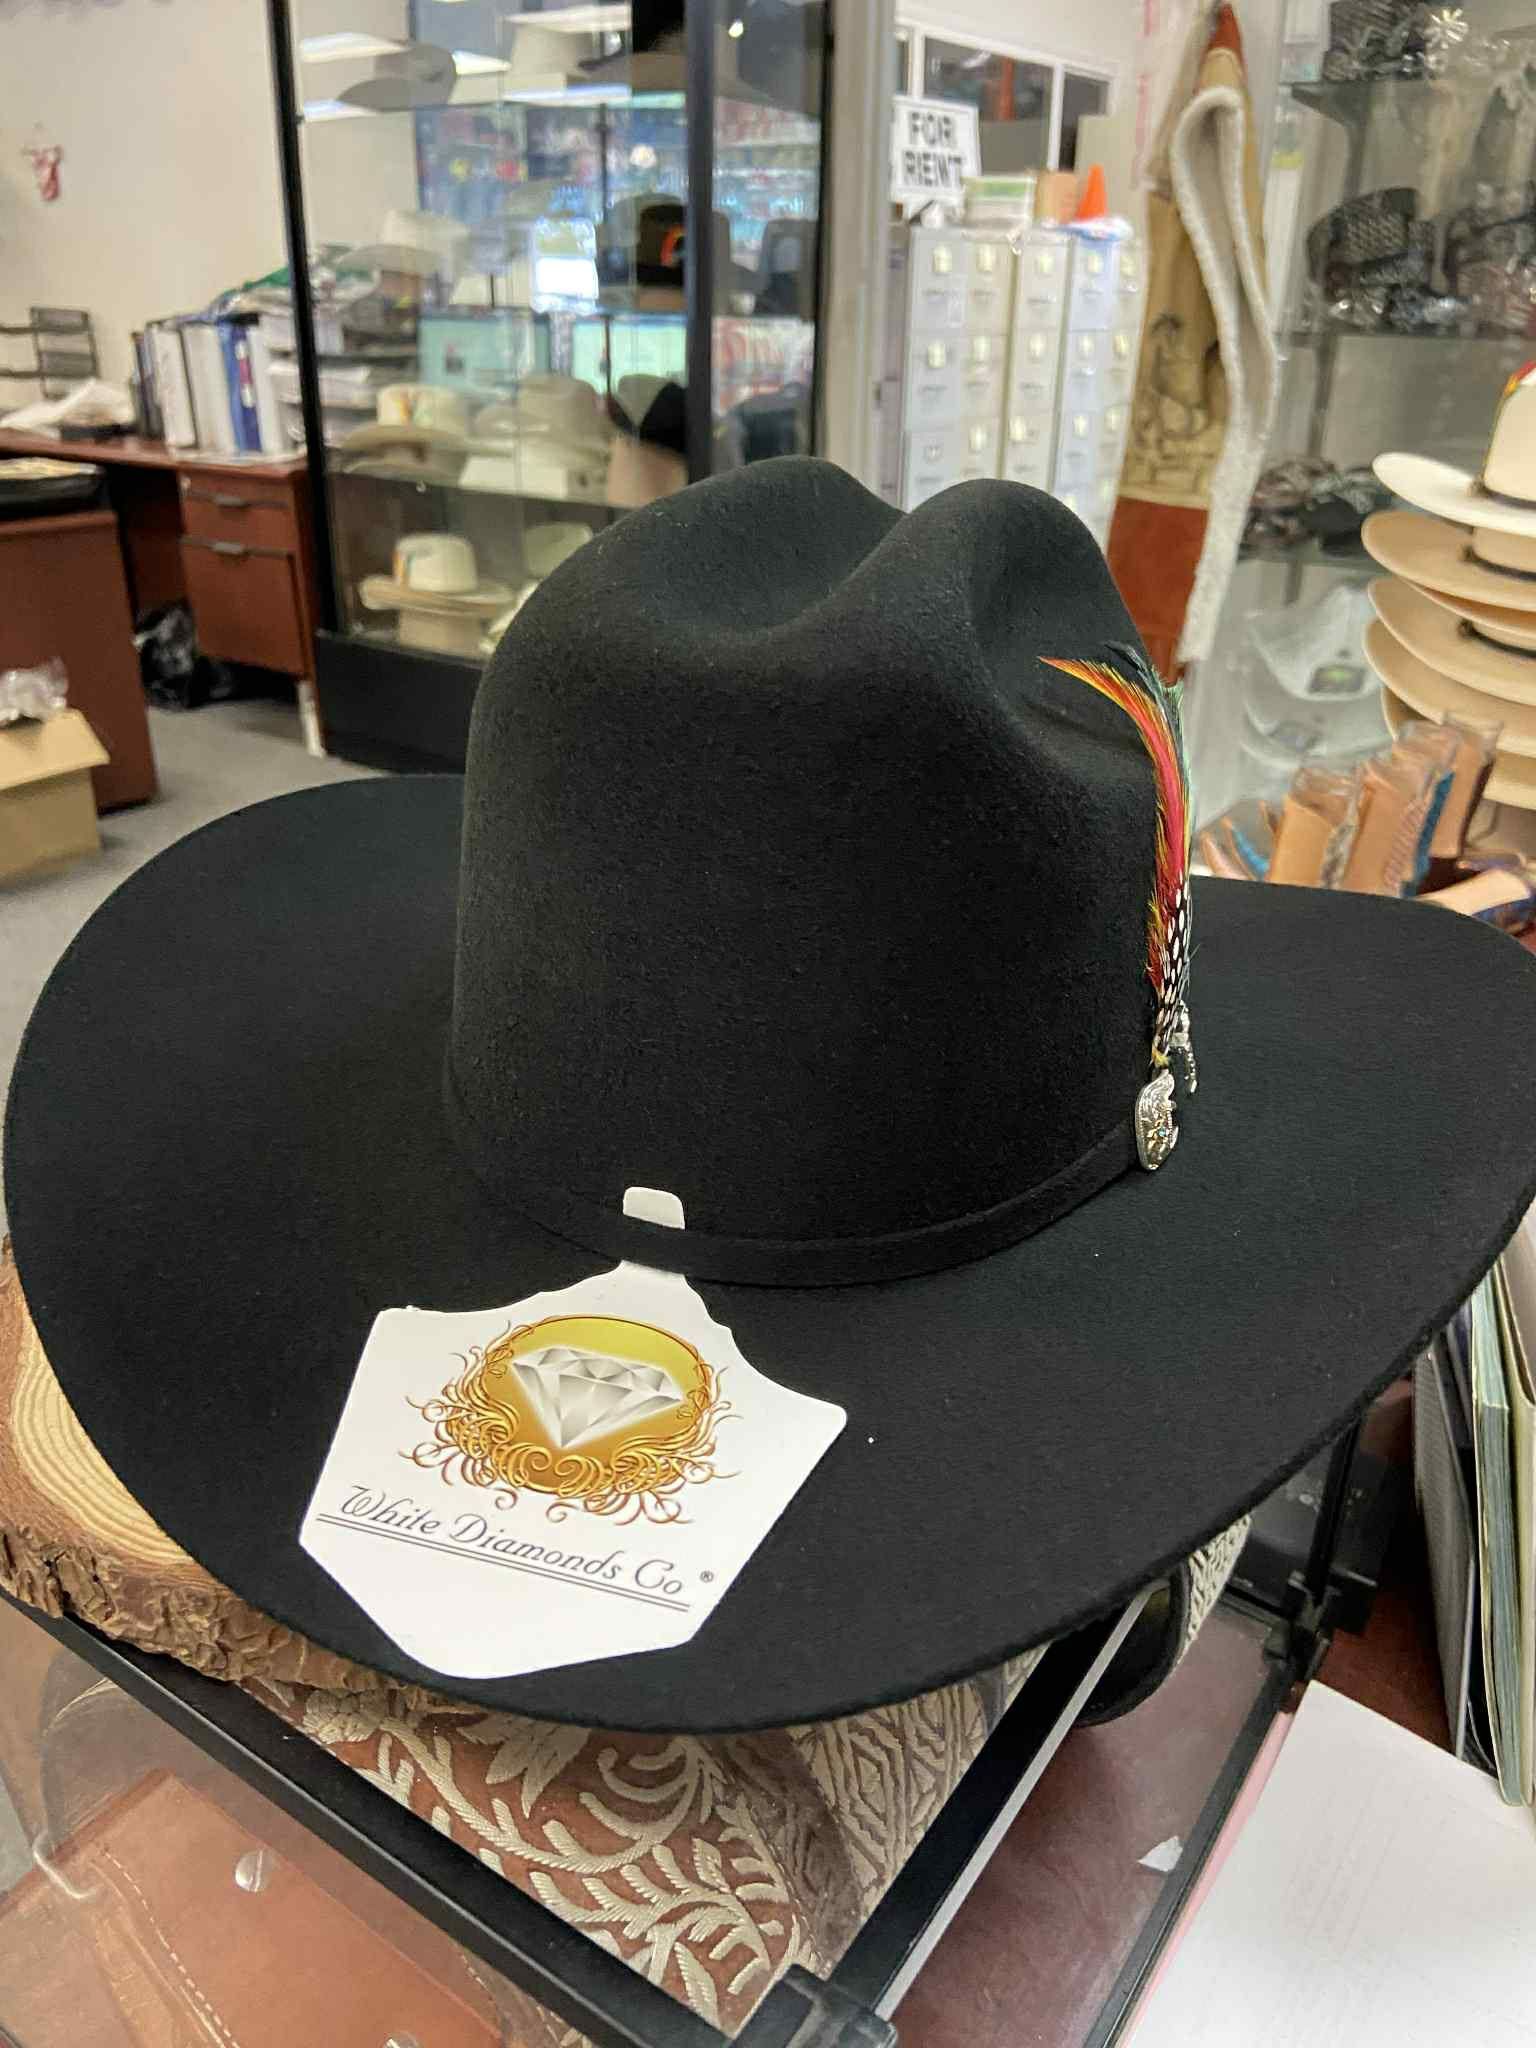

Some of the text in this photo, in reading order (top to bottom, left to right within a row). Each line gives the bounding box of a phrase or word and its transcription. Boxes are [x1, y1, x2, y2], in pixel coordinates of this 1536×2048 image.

[910, 111, 957, 147] FOR
[903, 150, 962, 187] RENT
[340, 1485, 440, 1535] White
[449, 1513, 626, 1581] Diamonds
[634, 1558, 683, 1596] Co
